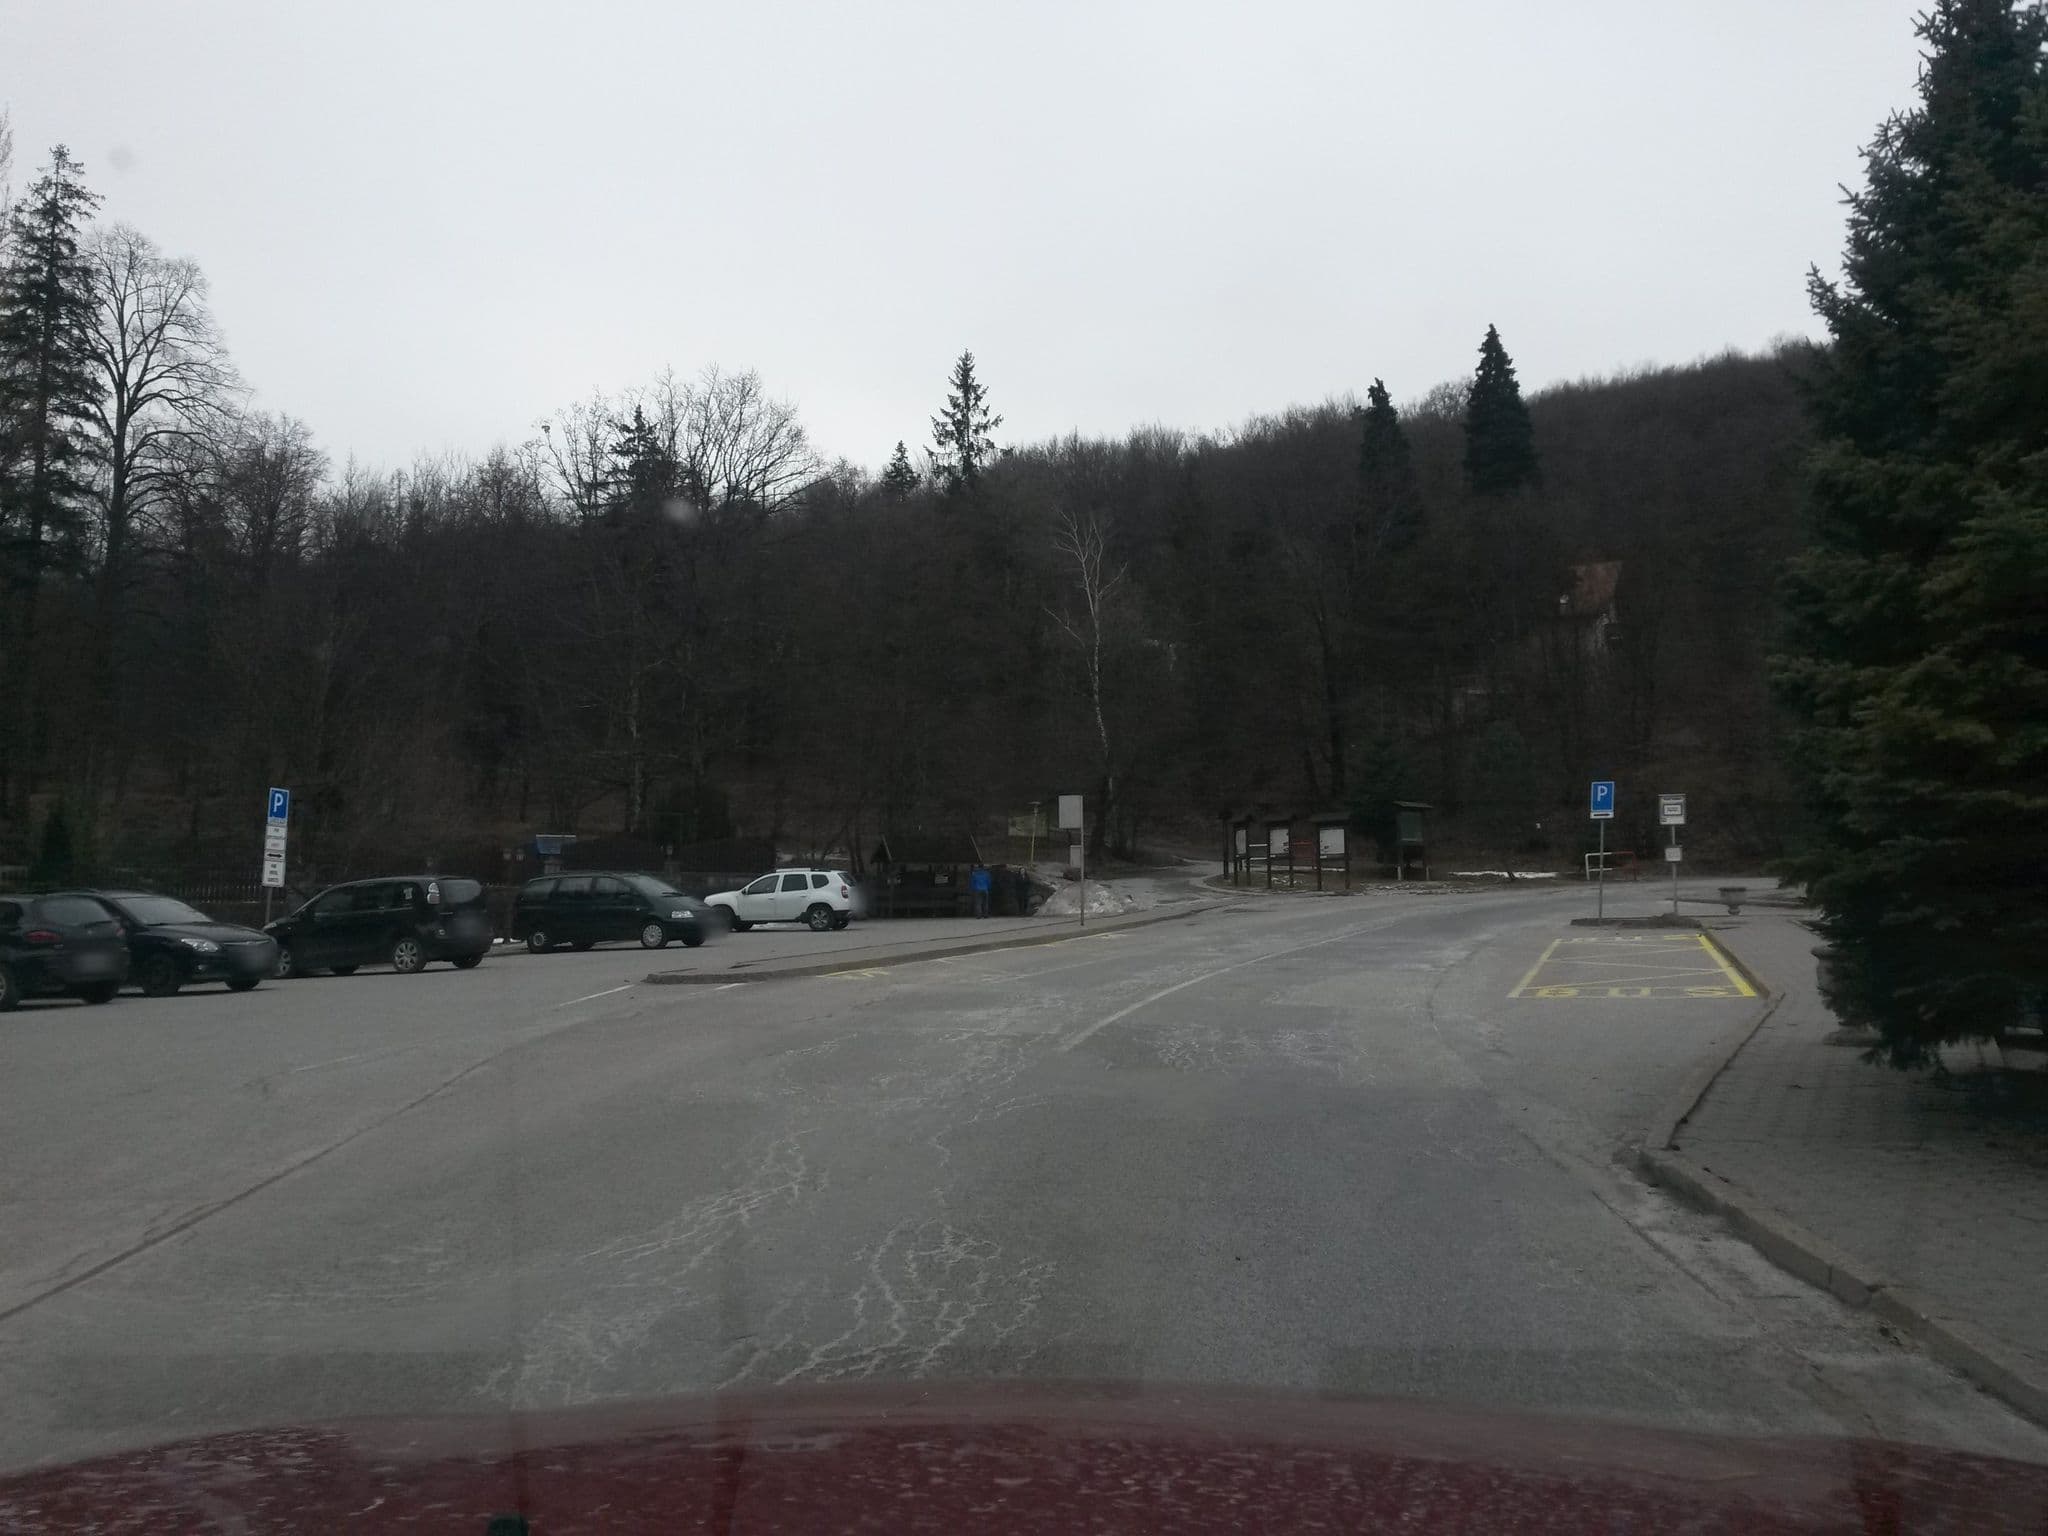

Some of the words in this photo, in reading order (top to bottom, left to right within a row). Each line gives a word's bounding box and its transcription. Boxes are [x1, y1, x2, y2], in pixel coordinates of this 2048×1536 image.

[1597, 785, 1608, 802] P
[273, 793, 284, 812] P
[1535, 987, 1729, 998] BUS
